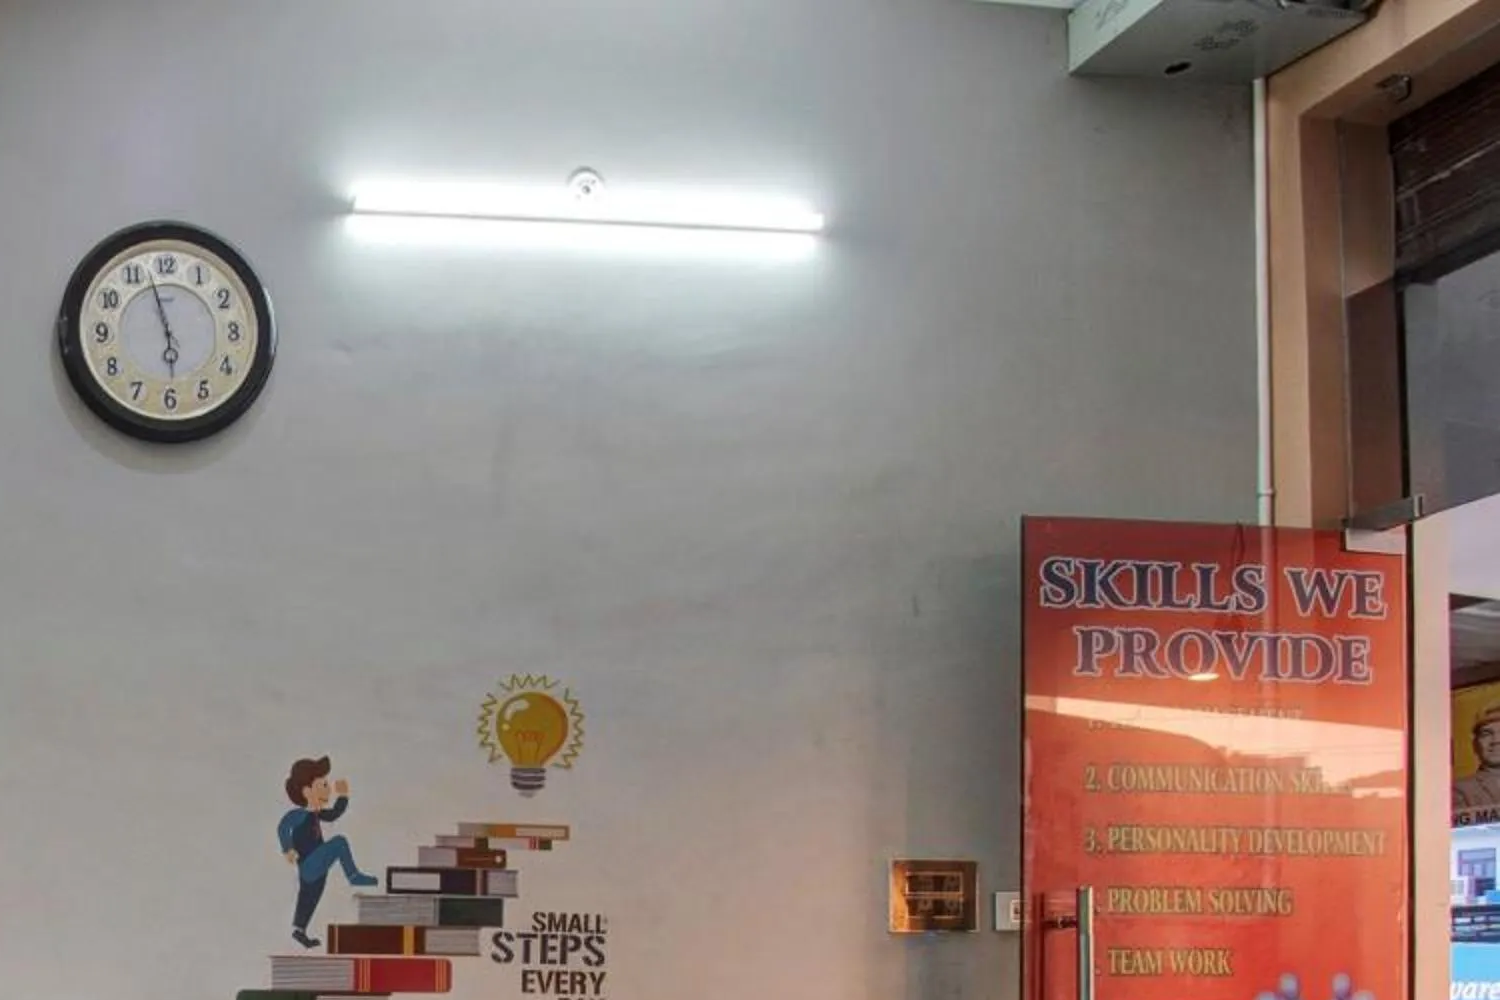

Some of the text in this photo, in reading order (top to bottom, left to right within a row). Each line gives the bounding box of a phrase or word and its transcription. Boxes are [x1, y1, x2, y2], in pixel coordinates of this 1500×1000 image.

[126, 266, 141, 284] 11
[157, 256, 175, 275] 12
[194, 266, 203, 285] 1
[102, 290, 119, 309] 10
[217, 288, 230, 309] 2
[95, 323, 109, 343] 9
[106, 357, 118, 377] 8
[219, 352, 233, 376] 4
[130, 381, 143, 401] 7
[163, 388, 177, 410] 6
[197, 380, 209, 400] 5
[1039, 556, 1388, 620] SKILLS WE
[1073, 625, 1374, 685] PROVIDE
[1085, 765, 1101, 791] 2.
[1106, 763, 1285, 793] COMMUNICATION
[1107, 825, 1243, 854] PERSONALITY
[1247, 827, 1387, 856] DEVELOPMENT
[1107, 886, 1203, 914] PROBLEM
[1207, 888, 1293, 916] SOLVING
[531, 911, 607, 934] SMALL
[491, 931, 605, 967] STEPS
[1107, 948, 1163, 976] TEAM
[1169, 949, 1233, 976] WORK
[521, 970, 606, 995] EVERY
